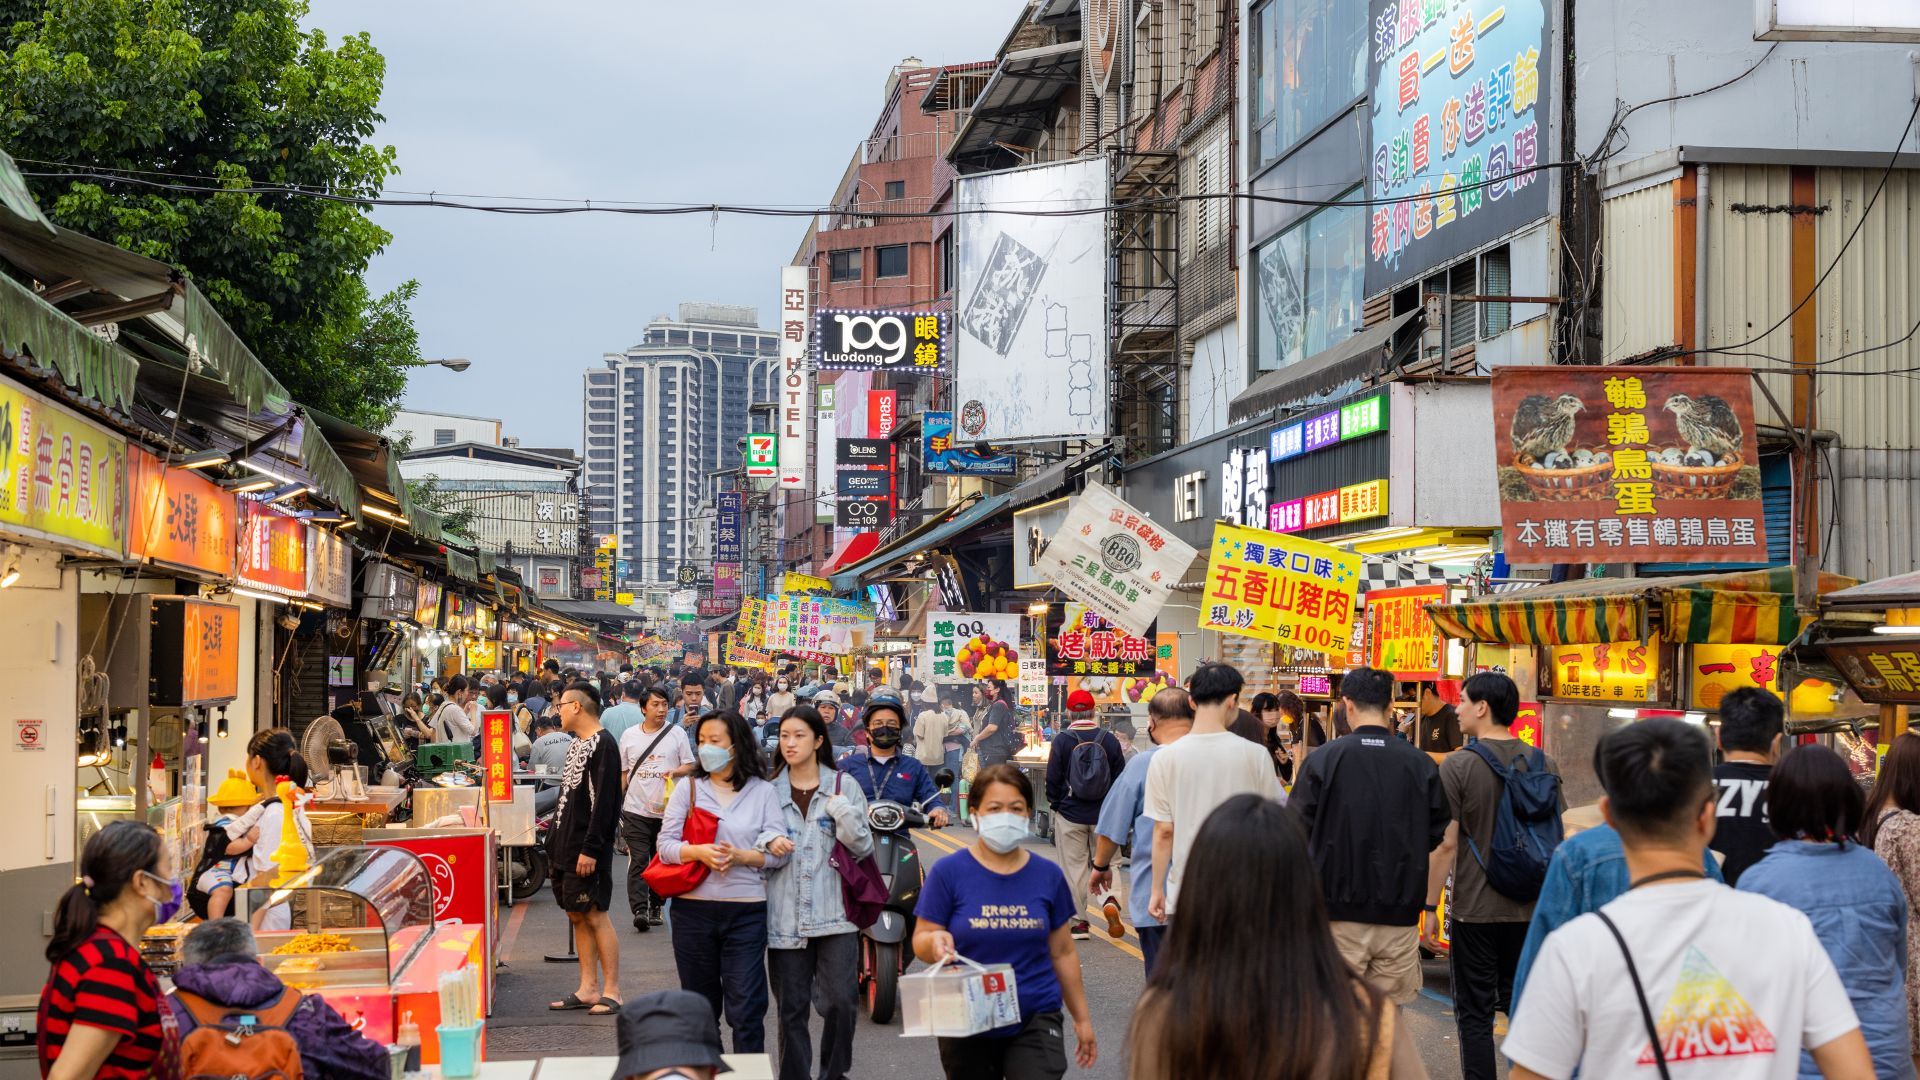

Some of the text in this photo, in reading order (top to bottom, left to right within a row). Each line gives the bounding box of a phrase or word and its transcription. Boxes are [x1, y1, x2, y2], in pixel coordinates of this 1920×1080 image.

[1399, 7, 1505, 112] 買一送一
[784, 288, 805, 343] 亞奇
[834, 314, 907, 364] 109
[913, 315, 940, 369] 眼鏡
[823, 351, 883, 366] Luodong
[785, 357, 801, 438] HOTEL
[849, 477, 868, 485] GEO
[1174, 470, 1206, 523] NET
[537, 500, 577, 521] 夜市
[720, 494, 736, 543] 向日葵
[861, 516, 878, 525] 109
[536, 528, 578, 549] 牛排
[1108, 508, 1166, 552] 正宗碳烤
[1106, 541, 1135, 567] BBQ
[1243, 541, 1334, 580] 獨家口味
[1211, 564, 1350, 625] 五香山豬肉
[778, 601, 788, 646] 西瓜汁
[956, 620, 986, 638] QQ
[1210, 605, 1255, 629] 現炒
[933, 620, 956, 677] 地瓜球
[1057, 631, 1149, 661] 烤魷魚
[1261, 623, 1346, 651] 一份100元
[1073, 661, 1136, 675] 獨家醬料
[1402, 640, 1425, 670] 100
